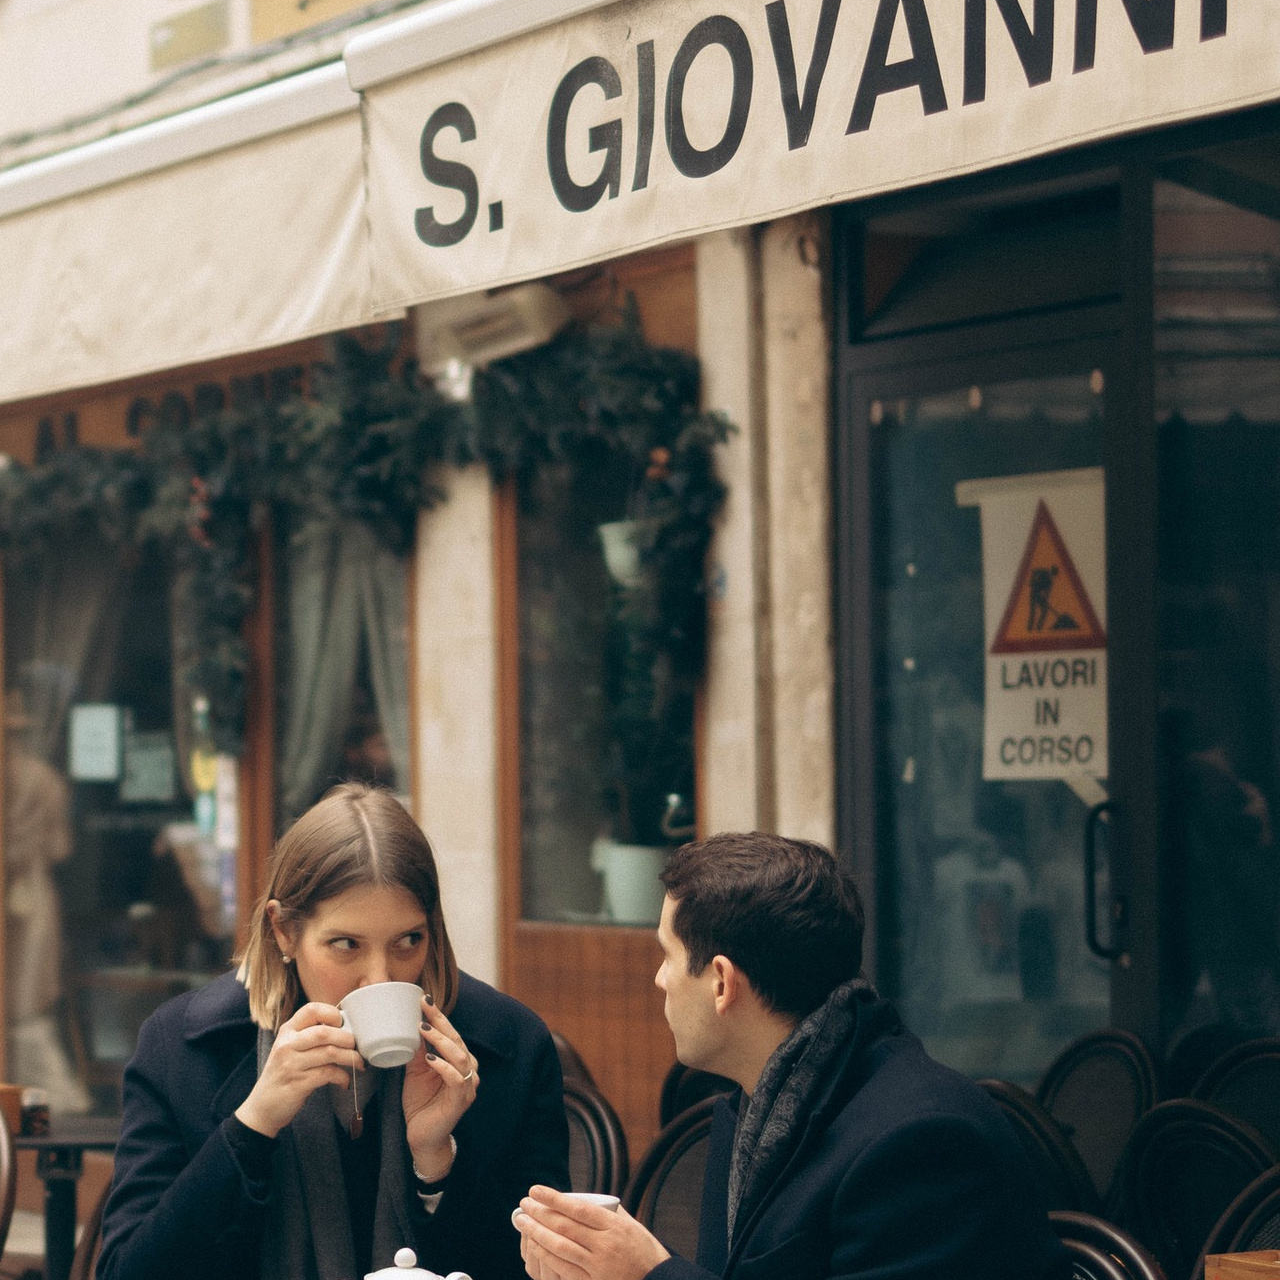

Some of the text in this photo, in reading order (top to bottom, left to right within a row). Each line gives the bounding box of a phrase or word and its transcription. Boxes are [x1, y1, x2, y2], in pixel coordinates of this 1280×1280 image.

[414, 101, 504, 249] S.
[1001, 657, 1098, 690] LAVORI
[1034, 697, 1061, 727] IN
[999, 735, 1095, 766] CORSO
